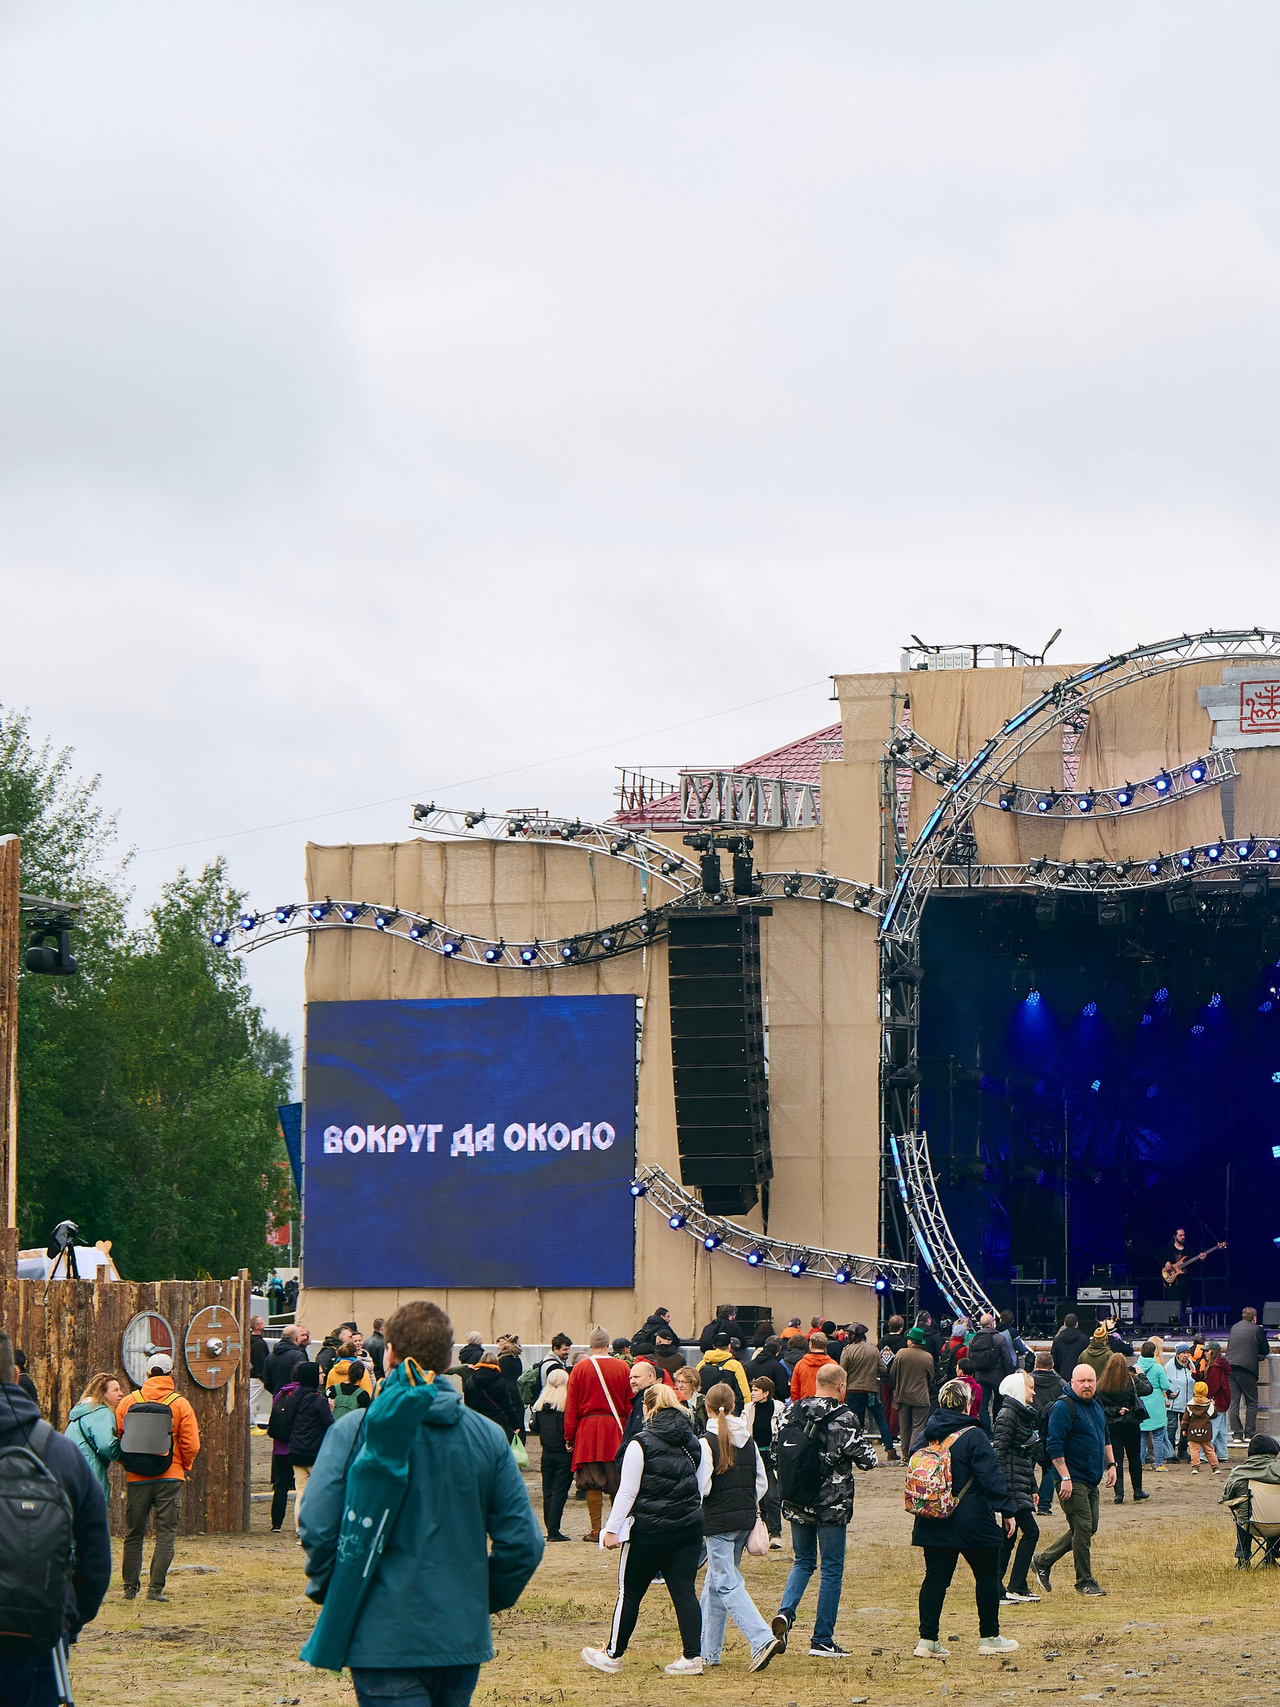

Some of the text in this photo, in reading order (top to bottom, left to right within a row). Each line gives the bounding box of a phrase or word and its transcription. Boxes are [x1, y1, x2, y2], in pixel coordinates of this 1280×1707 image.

[323, 1121, 616, 1157] ВОКРУГ ДА ОКОЛО
